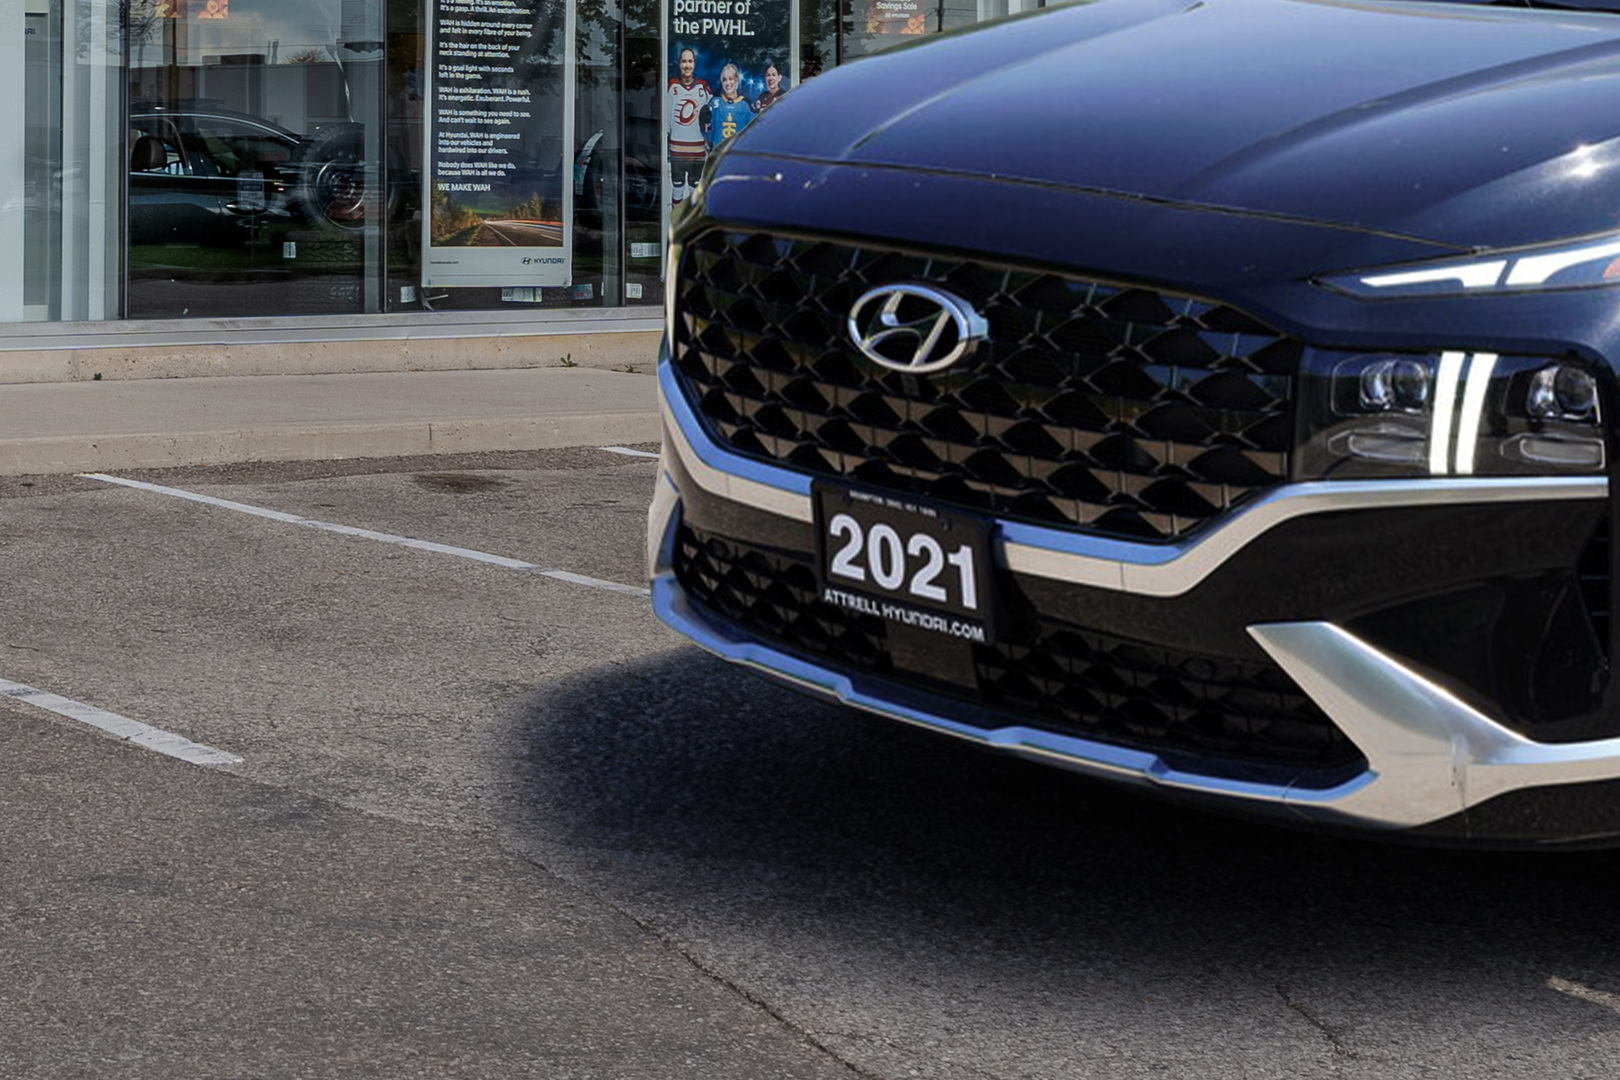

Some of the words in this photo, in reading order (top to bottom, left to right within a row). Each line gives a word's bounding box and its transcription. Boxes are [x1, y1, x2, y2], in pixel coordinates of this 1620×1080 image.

[877, 2, 902, 11] Savings
[903, 2, 917, 10] Sale
[673, 17, 699, 34] the
[702, 18, 755, 36] PWHL.
[829, 513, 977, 610] 2021
[824, 588, 880, 617] ATTRELL
[882, 603, 985, 642] HYUNDAI.COM
